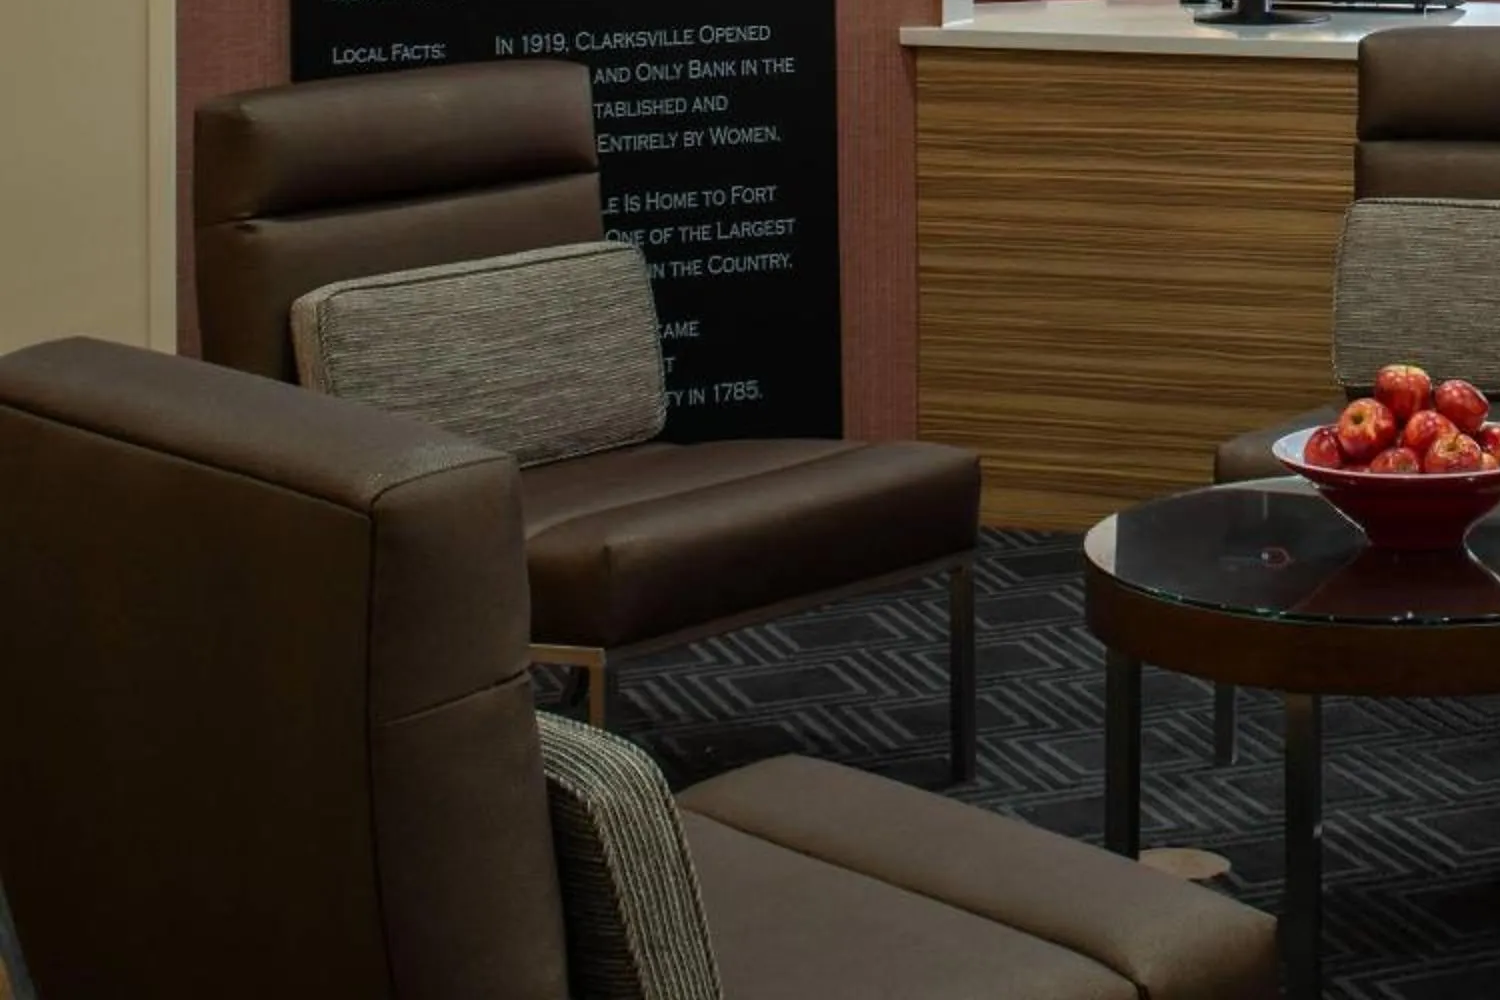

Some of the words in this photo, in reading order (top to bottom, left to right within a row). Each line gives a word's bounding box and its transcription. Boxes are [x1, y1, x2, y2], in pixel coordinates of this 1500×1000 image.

[495, 37, 514, 55] IN
[575, 27, 695, 51] CLARKSVILLE
[699, 24, 770, 43] OPENED
[332, 47, 388, 64] LOCAL
[594, 68, 631, 84] AND
[635, 64, 684, 82] ONLY
[688, 61, 737, 79] BANK
[741, 60, 757, 75] IN
[762, 57, 795, 73] THE
[593, 98, 687, 119] TABLISHED
[691, 97, 728, 113] AND
[598, 135, 678, 154] ENTIRELY
[683, 133, 704, 148] BY
[710, 126, 782, 146] WOMEN.
[625, 195, 641, 214] IS
[645, 191, 699, 210] HOME
[703, 190, 726, 207] TO
[731, 185, 777, 205] FORT
[649, 228, 674, 245] OF
[678, 225, 712, 242] THE
[717, 218, 796, 240] LARGEST
[670, 260, 703, 277] THE
[707, 253, 793, 274] COUNTRY.
[689, 387, 705, 406] IN
[714, 380, 763, 401] 1785.
